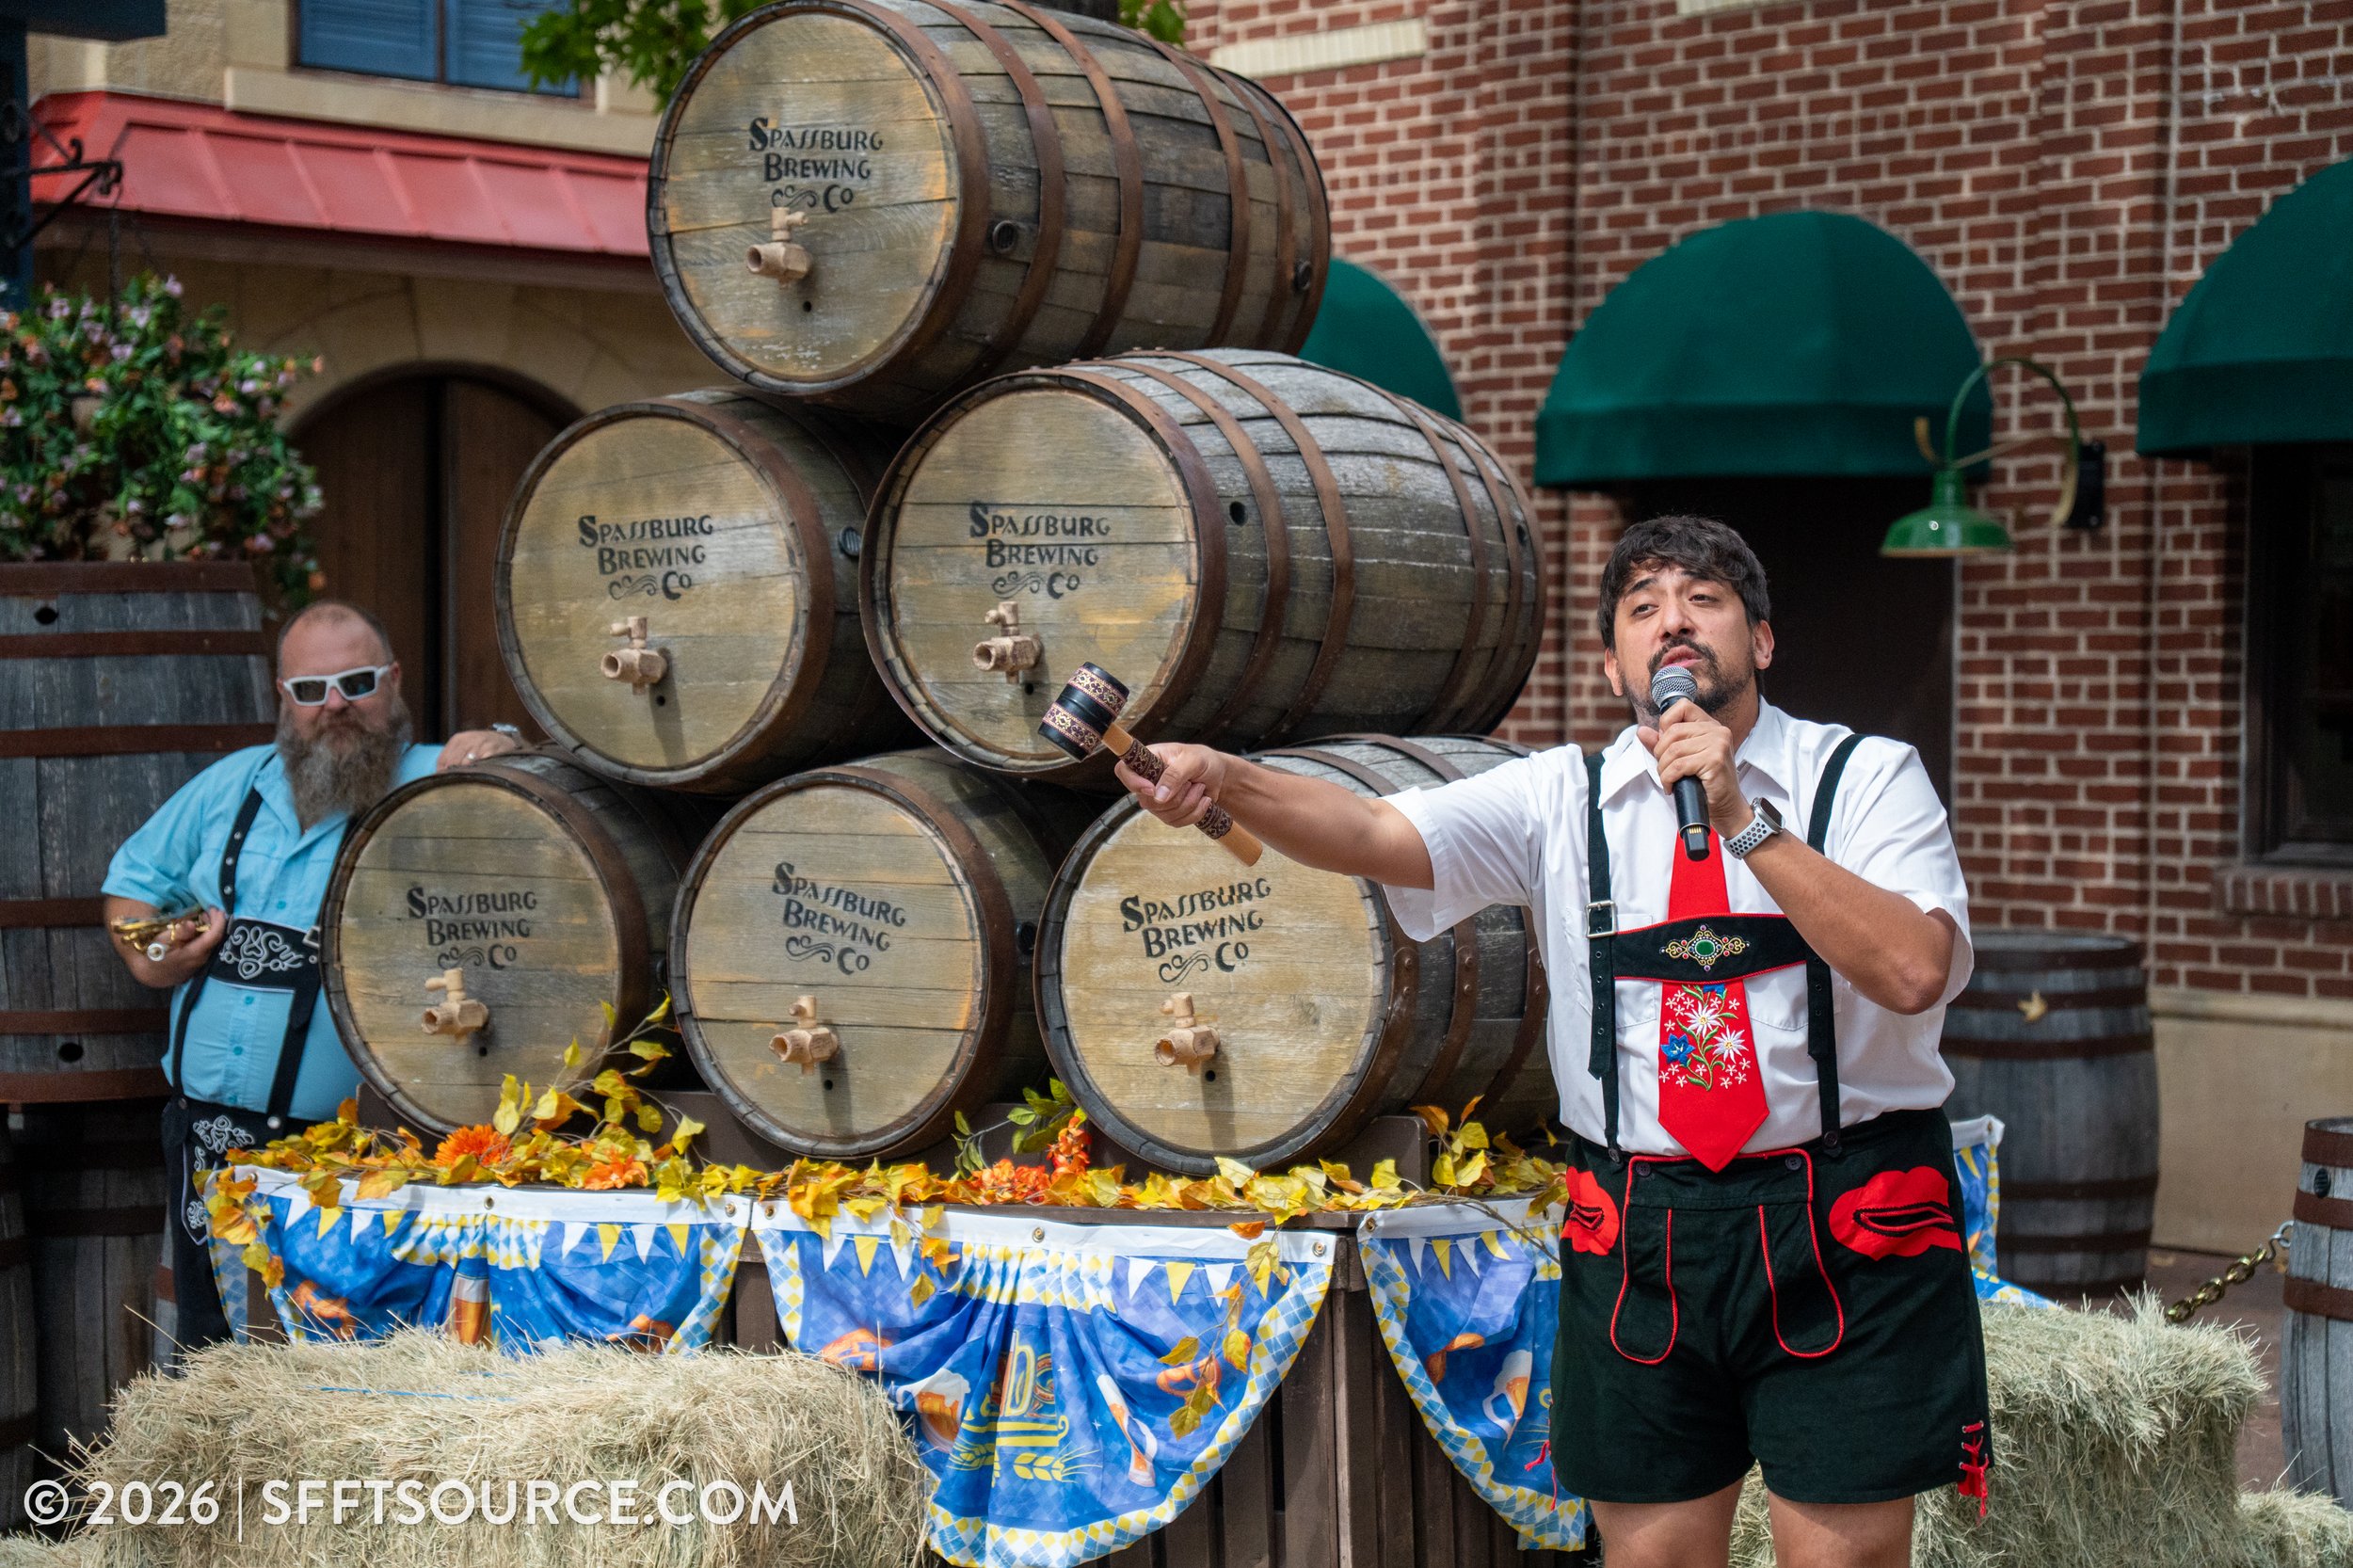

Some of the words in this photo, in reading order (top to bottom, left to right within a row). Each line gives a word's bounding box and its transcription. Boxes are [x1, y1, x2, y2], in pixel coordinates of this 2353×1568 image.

[763, 152, 871, 183] BREWING
[598, 544, 706, 575] BREWING
[985, 537, 1099, 568] BREWING
[425, 918, 531, 947] BREWING
[783, 898, 890, 952] BREWING
[1142, 909, 1264, 958] BREWING
